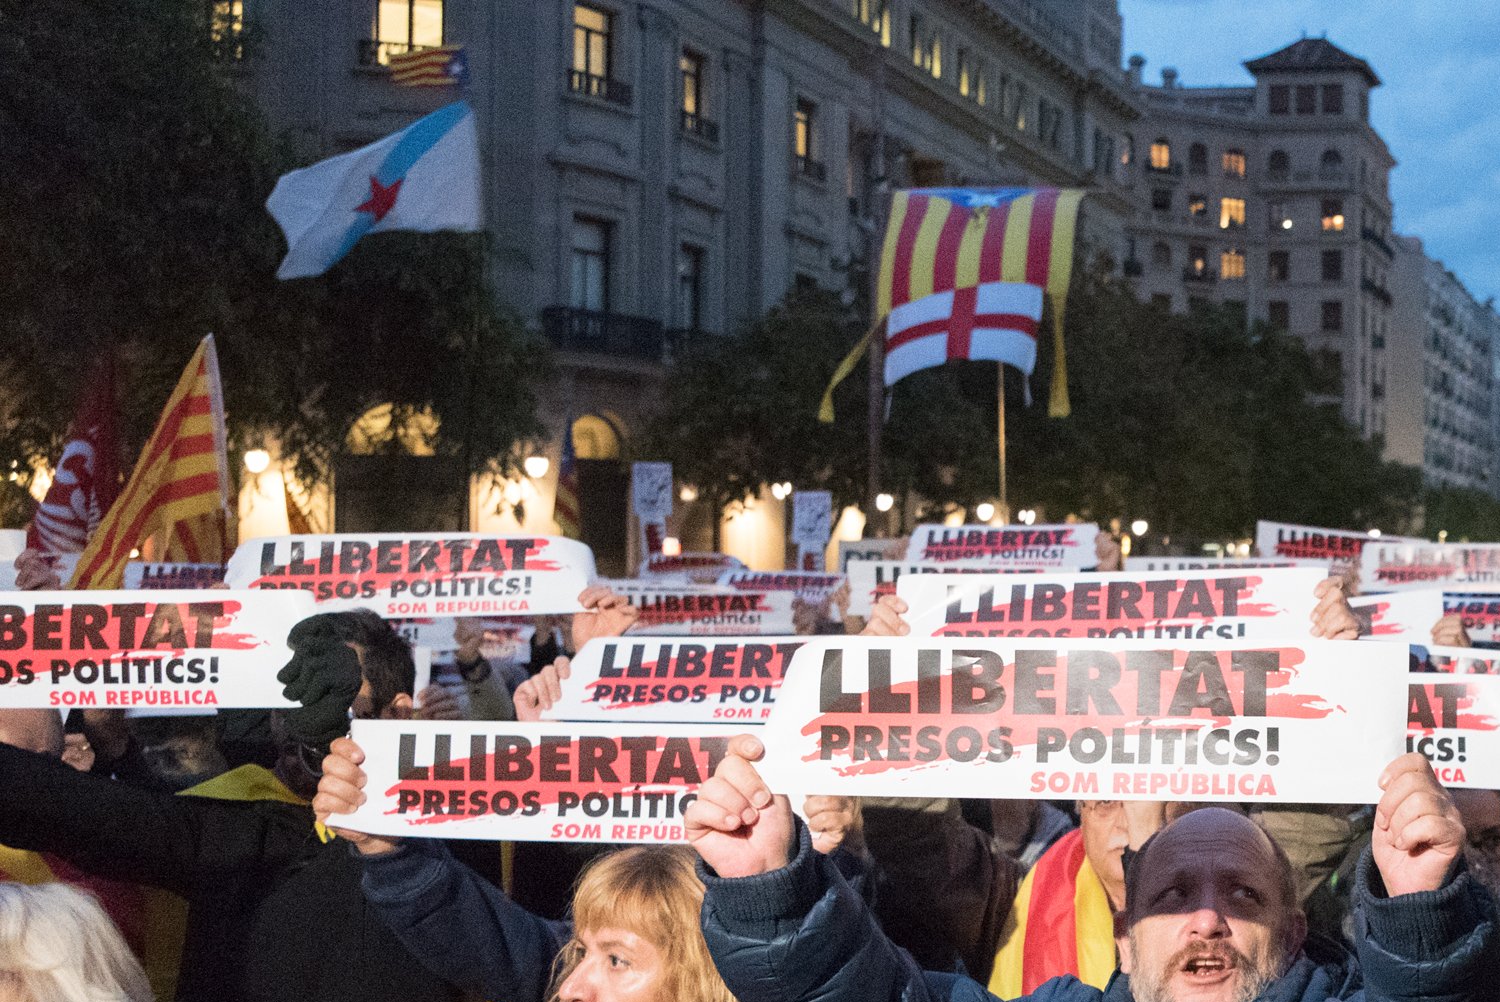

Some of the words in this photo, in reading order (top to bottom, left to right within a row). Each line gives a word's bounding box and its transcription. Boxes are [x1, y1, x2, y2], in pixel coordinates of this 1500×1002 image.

[927, 530, 1068, 546] LLIBERTAT
[260, 539, 535, 576] LLIBERTAT
[390, 571, 533, 598] POLÍTICS!
[387, 603, 427, 614] SOM
[945, 577, 1247, 624] LLIBERTAT
[50, 652, 219, 685] POLÍTICS!
[50, 690, 97, 706] SOM
[106, 686, 218, 705] REPÚBLICA
[593, 684, 711, 704] PRESOS
[820, 649, 1280, 717] LLIBERTAT
[712, 708, 753, 719] SOM
[819, 725, 1013, 762] PRESOS
[1036, 719, 1280, 766] POLÍTICS!
[1030, 771, 1100, 794] SOM
[1113, 767, 1277, 796] REPÚBLICA
[397, 789, 541, 816] PRESOS
[551, 823, 601, 839] SOM
